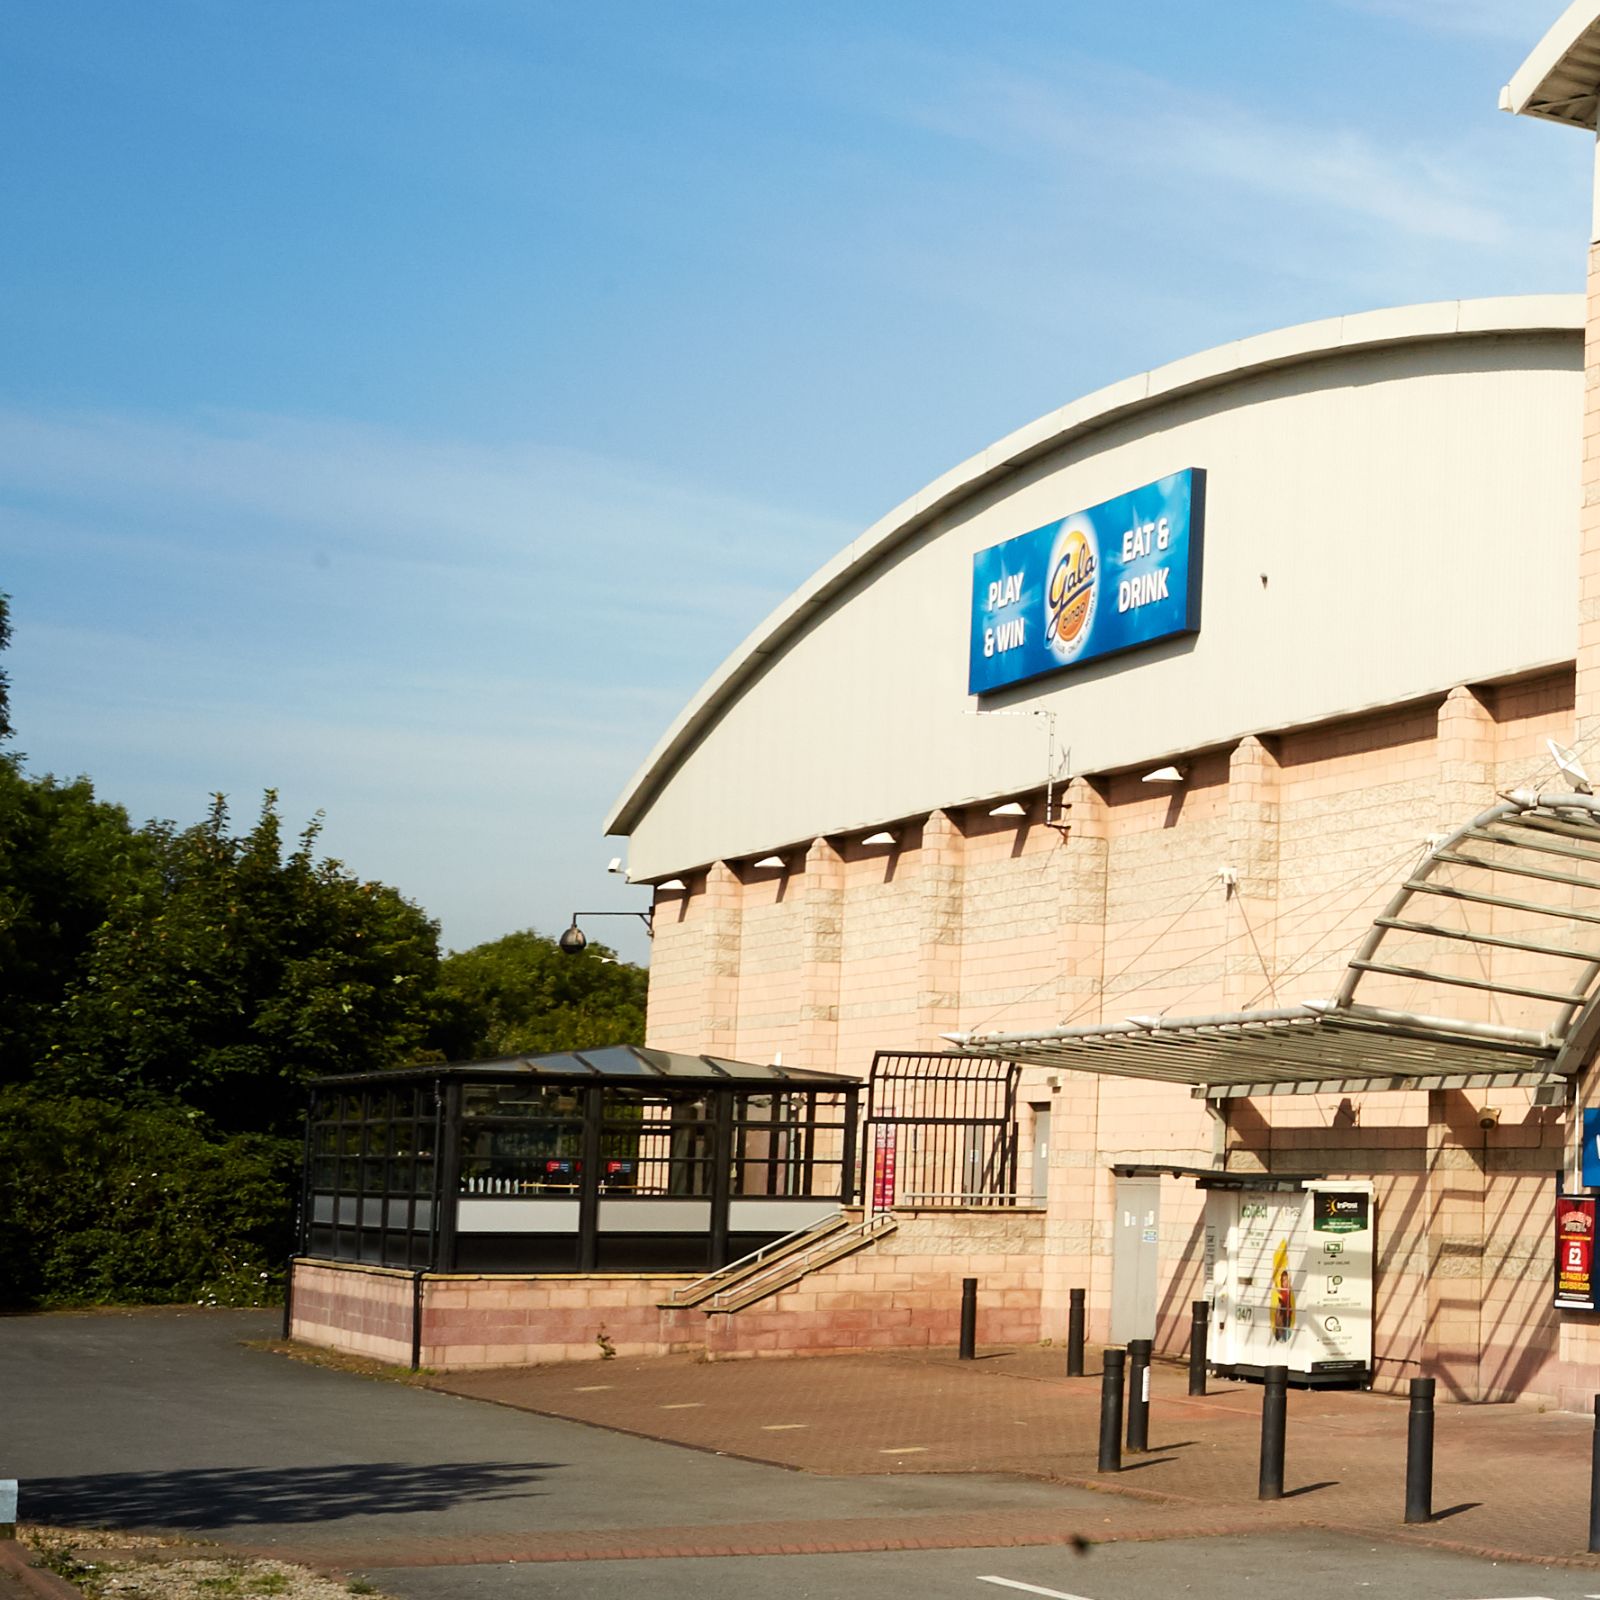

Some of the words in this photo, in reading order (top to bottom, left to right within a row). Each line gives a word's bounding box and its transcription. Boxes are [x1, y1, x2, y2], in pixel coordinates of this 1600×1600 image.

[1122, 522, 1155, 564] EAT
[1157, 517, 1170, 551] &
[988, 572, 1025, 612] PLAY
[1118, 567, 1170, 613] DRINK
[984, 628, 994, 658] &
[997, 617, 1025, 654] WIN
